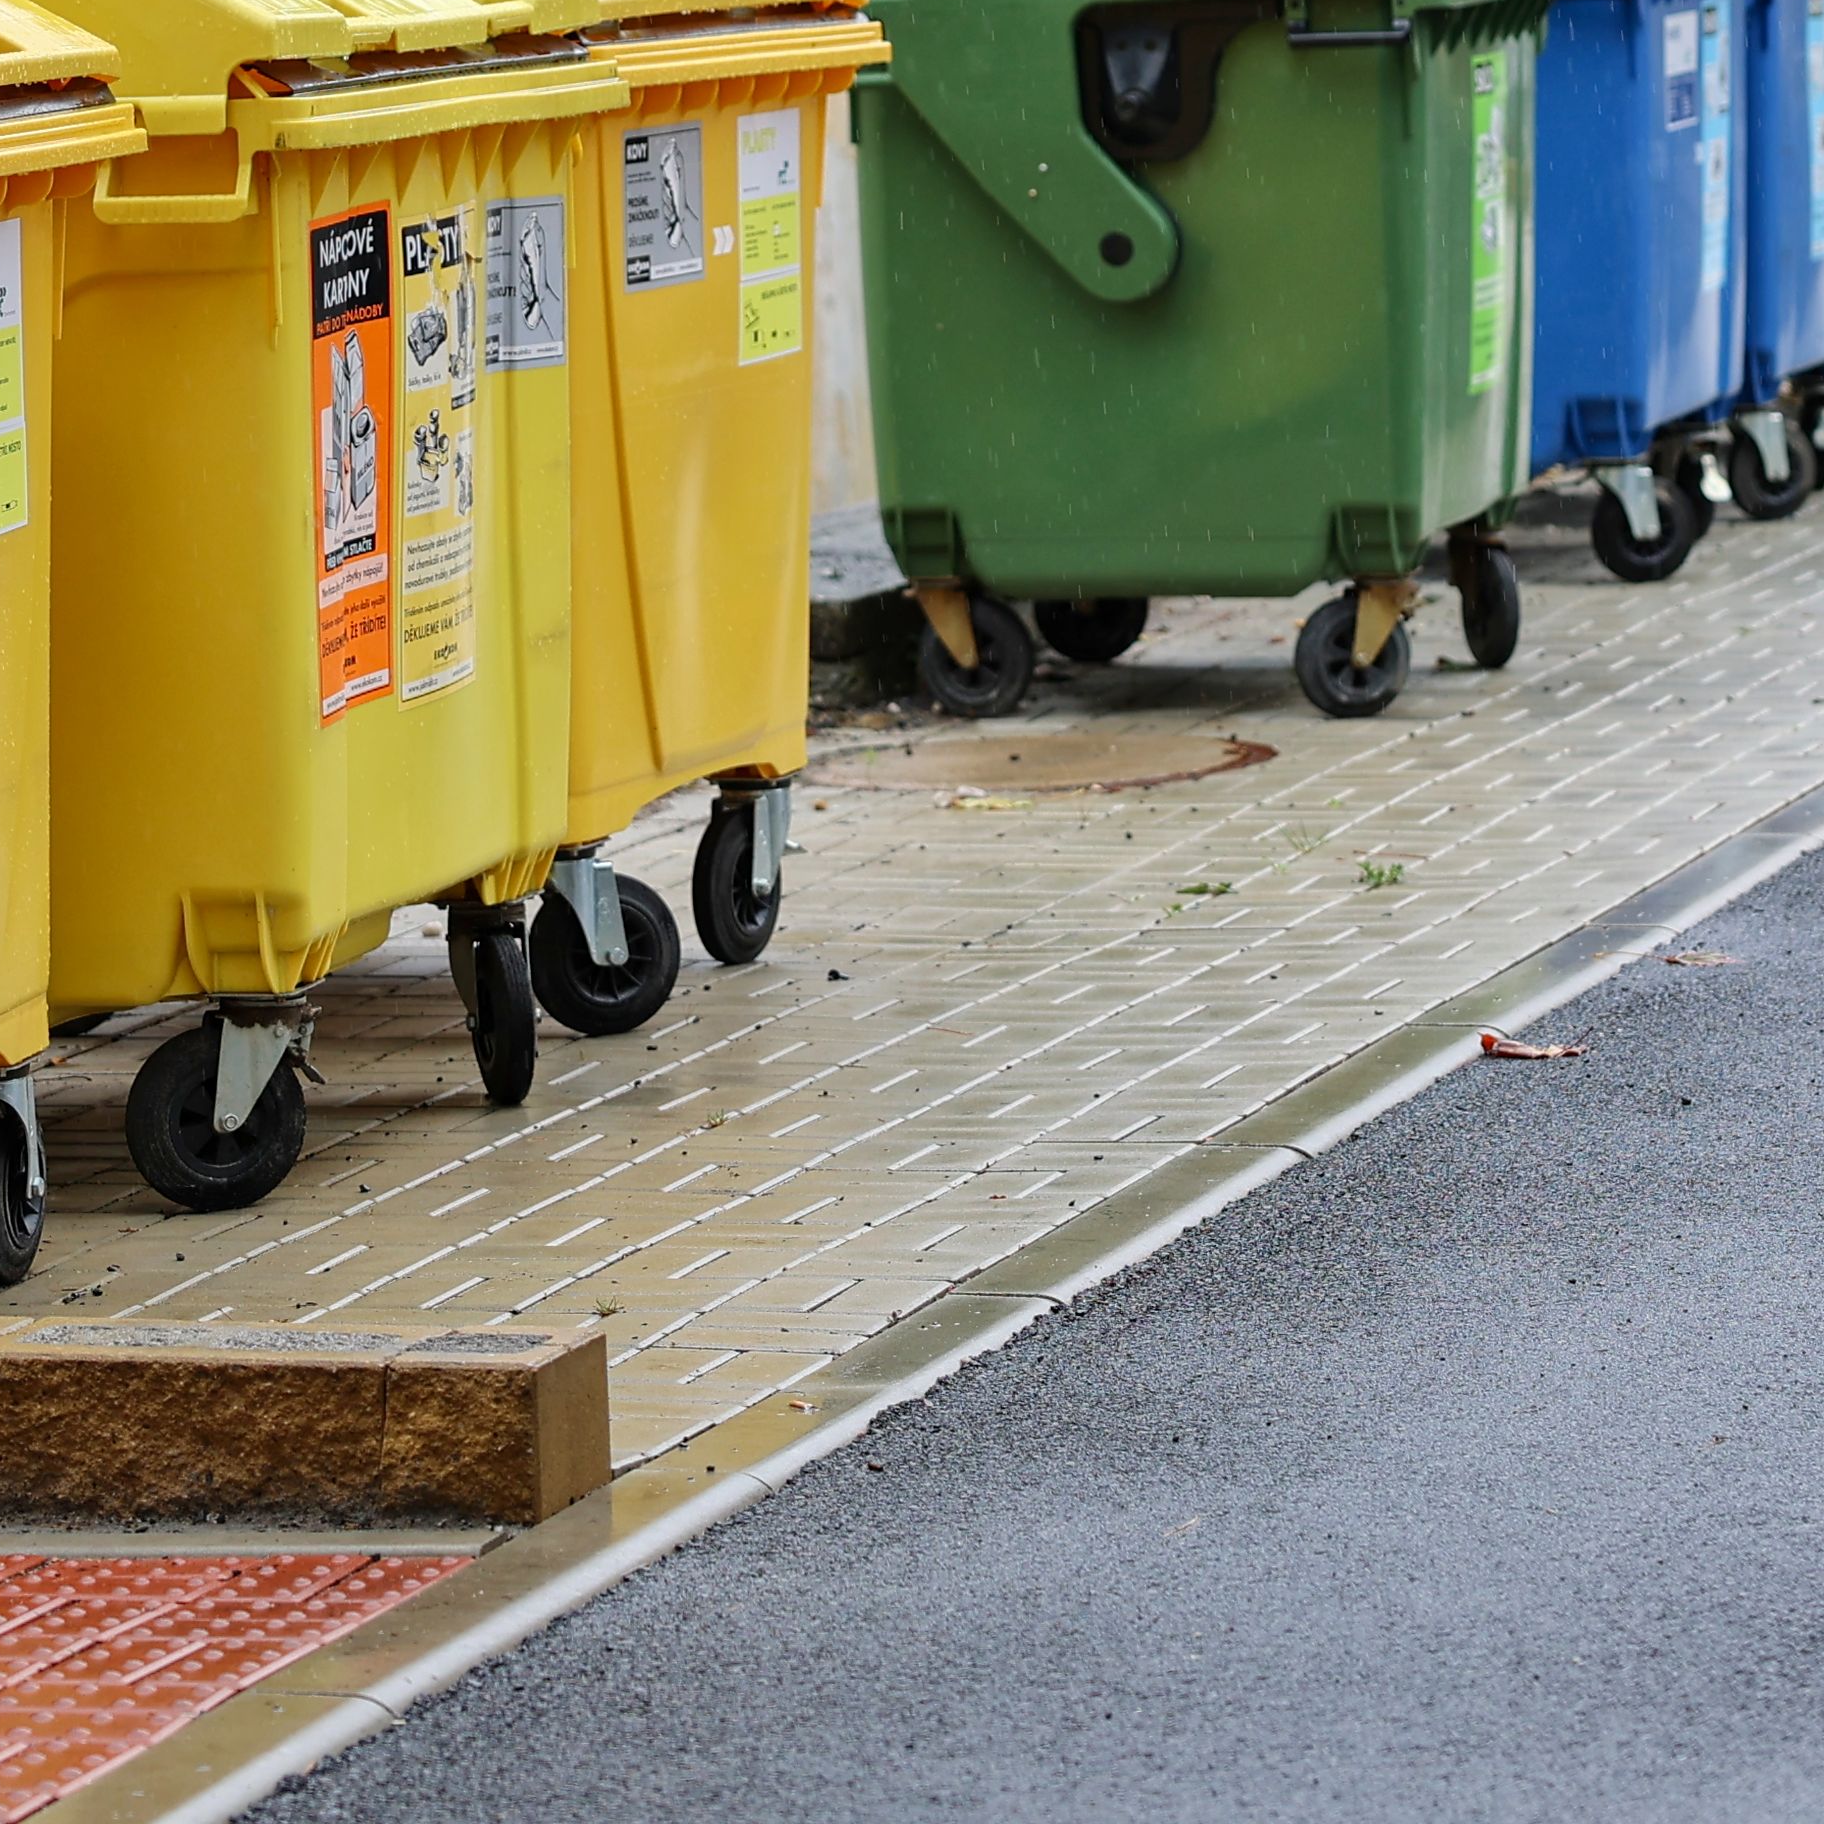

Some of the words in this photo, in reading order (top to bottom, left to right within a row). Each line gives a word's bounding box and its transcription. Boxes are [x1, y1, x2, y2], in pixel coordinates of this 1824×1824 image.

[627, 143, 647, 160] KOVY
[346, 302, 383, 322] NÁDOBY
[360, 614, 386, 636] TŘÍDÍTE!
[404, 620, 439, 643] DĚKUJEME
